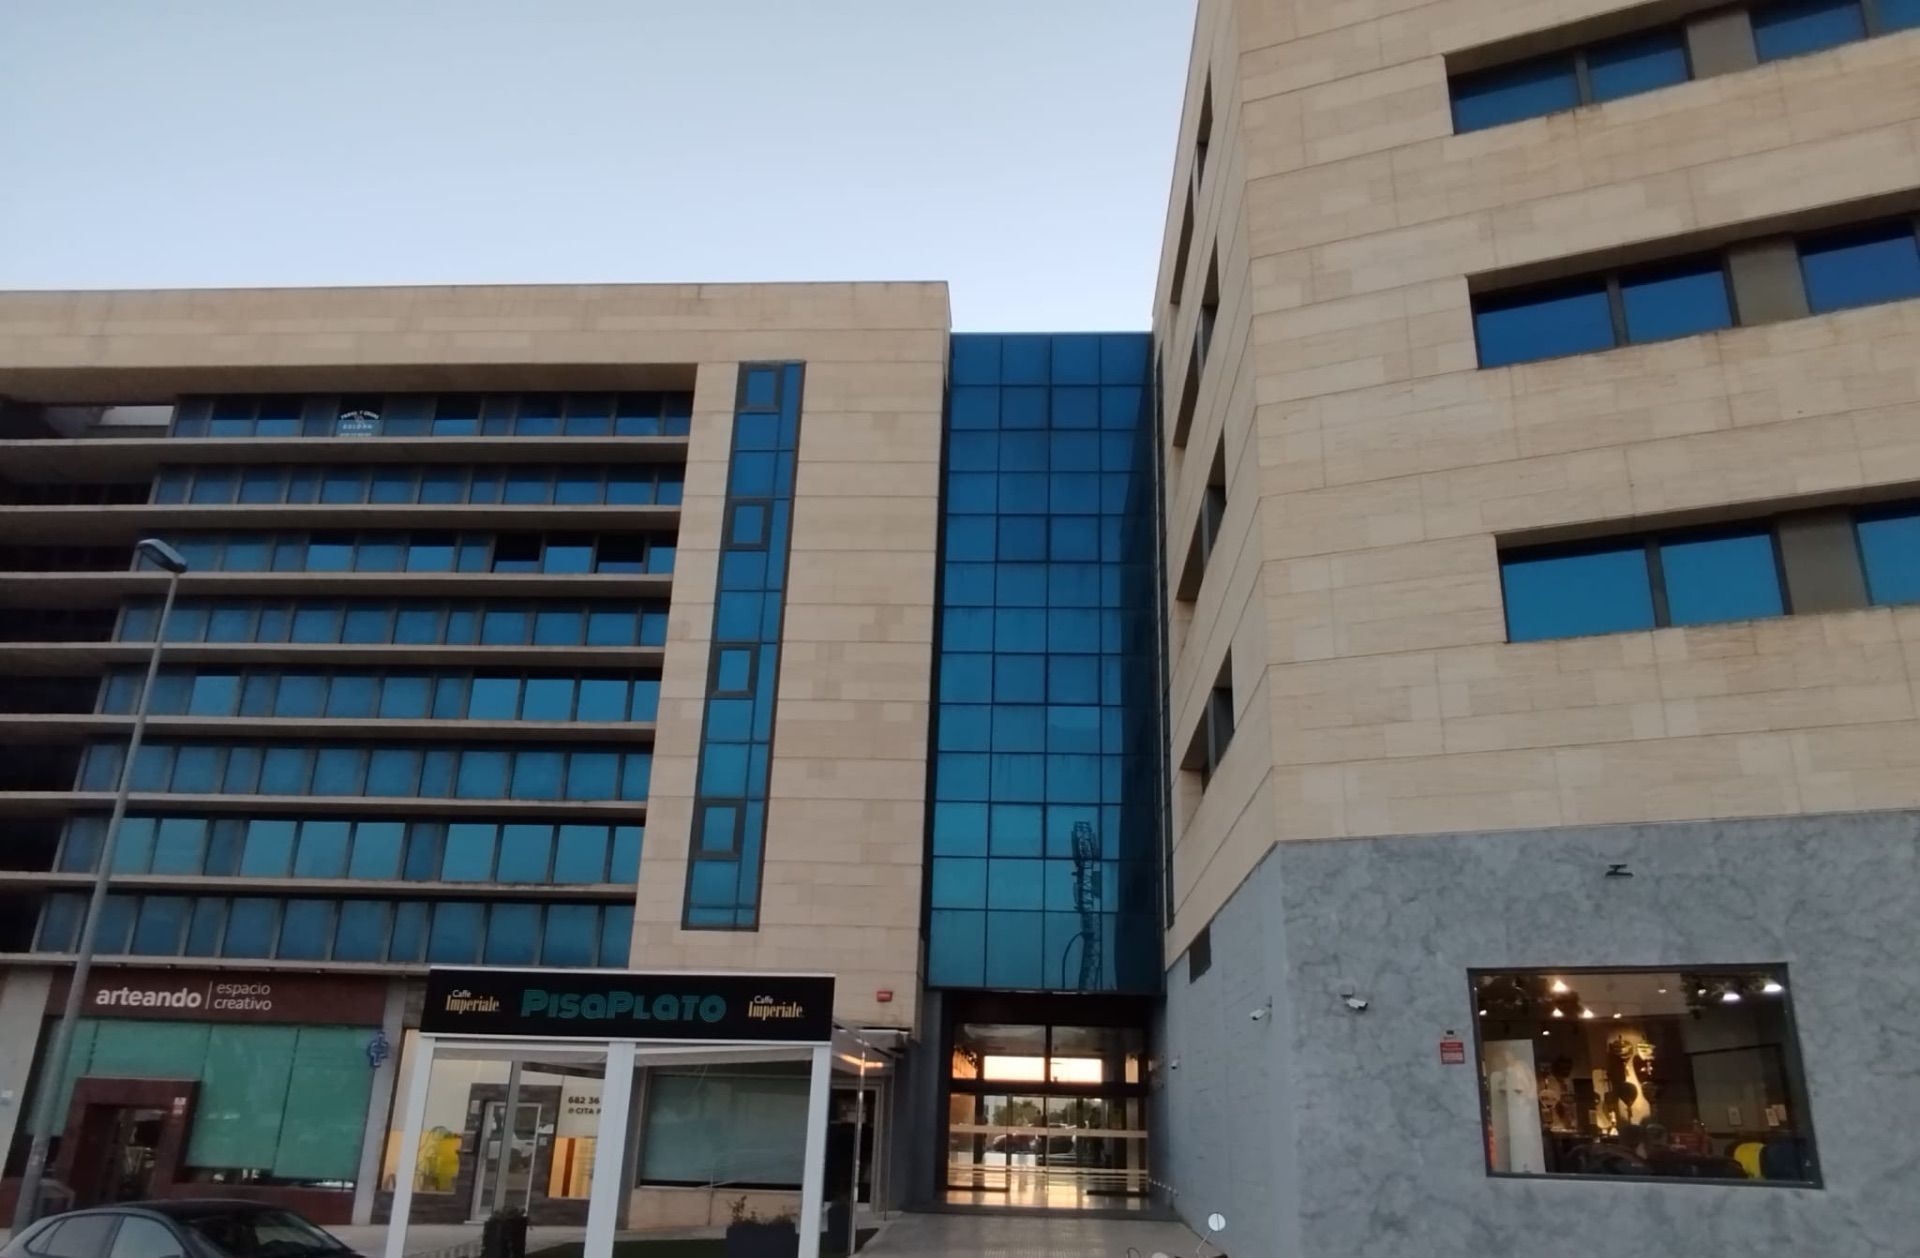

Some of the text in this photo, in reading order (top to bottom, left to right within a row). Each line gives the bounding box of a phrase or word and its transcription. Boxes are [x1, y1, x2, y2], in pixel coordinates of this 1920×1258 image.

[96, 987, 202, 1008] arteando
[216, 983, 271, 997] espacio
[214, 997, 273, 1011] creativo
[446, 994, 500, 1015] Imperiale
[748, 1001, 804, 1021] Imperiale
